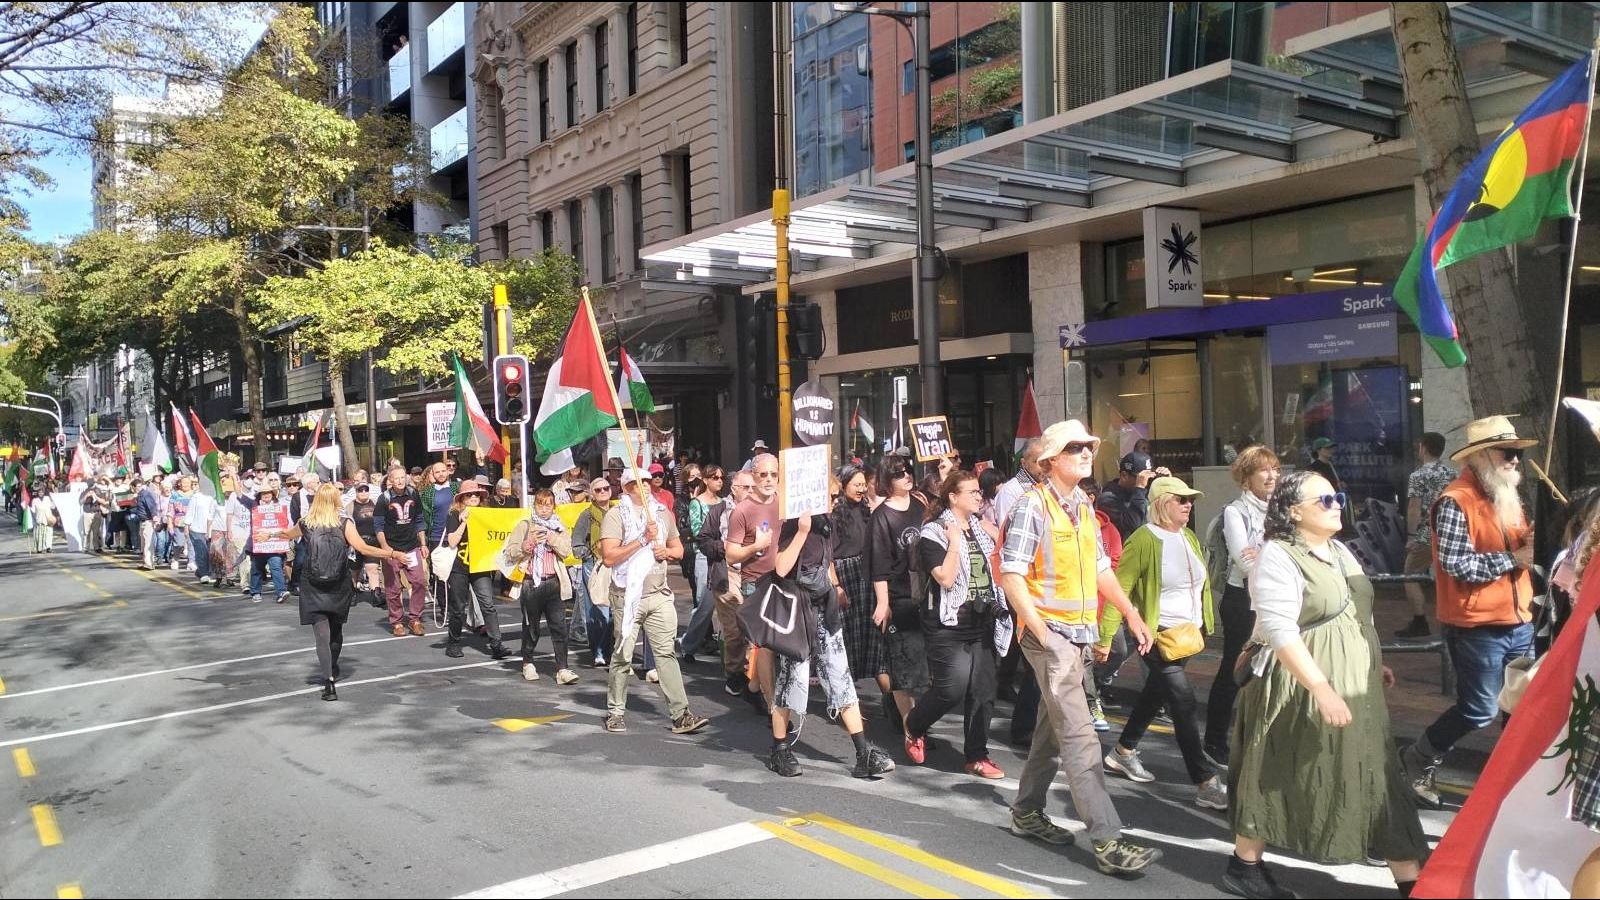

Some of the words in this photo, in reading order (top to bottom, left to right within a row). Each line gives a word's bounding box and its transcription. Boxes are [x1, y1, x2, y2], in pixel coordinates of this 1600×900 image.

[1168, 279, 1193, 293] Spark
[1343, 293, 1385, 314] Spark
[1358, 320, 1390, 330] SAMSUNG
[794, 395, 834, 411] BILLIONAIRES
[795, 417, 834, 436] HUMANITY
[917, 423, 942, 434] Hands
[918, 438, 950, 457] Iran
[1337, 441, 1372, 453] PARK
